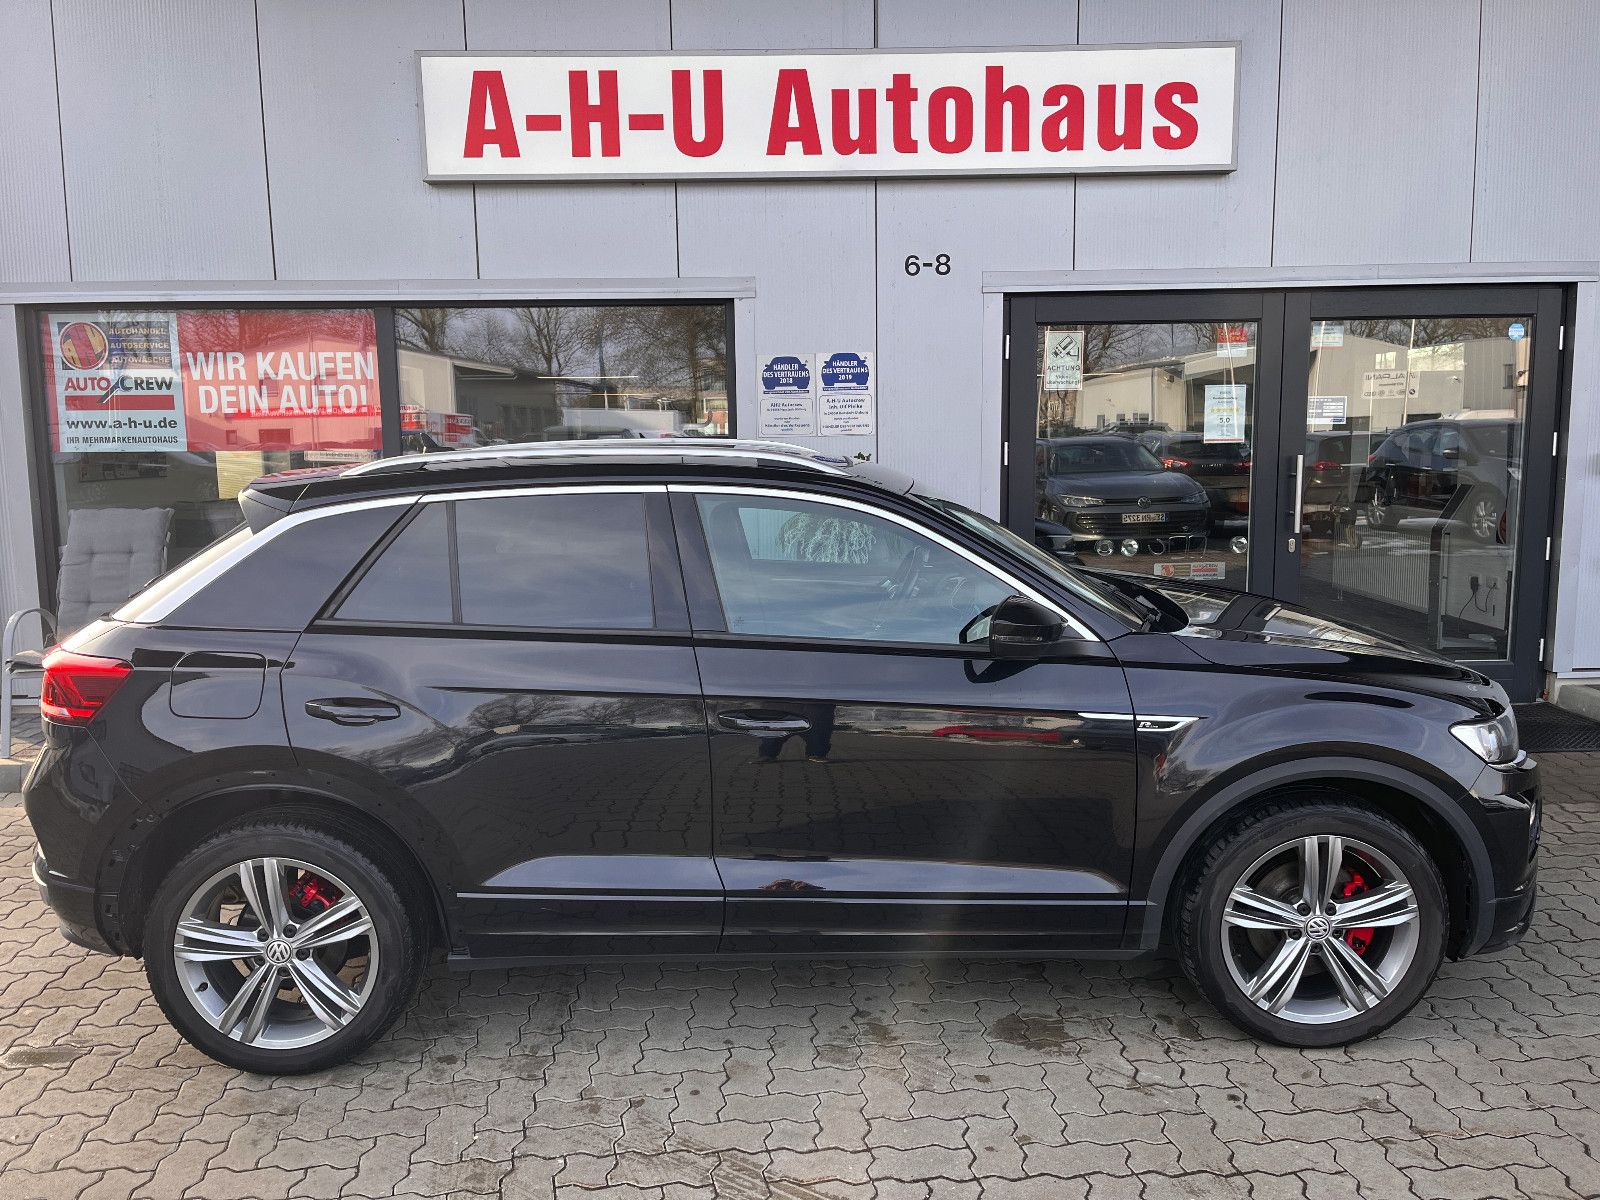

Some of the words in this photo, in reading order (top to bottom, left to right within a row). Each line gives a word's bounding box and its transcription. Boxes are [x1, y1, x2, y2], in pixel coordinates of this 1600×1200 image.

[463, 69, 724, 158] A-H-U
[766, 65, 1199, 156] Autohaus
[904, 253, 951, 276] 6-8
[108, 327, 166, 335] AUTOHANDEL
[186, 351, 247, 381] WIR
[256, 351, 374, 381] KAUFEN
[773, 363, 798, 371] HÄNDLER
[198, 385, 268, 414] DEIN
[279, 384, 368, 414] AUTO!
[66, 417, 178, 429] www.a-h-u.de
[82, 436, 178, 444] MEHRMARKENAUTOHAUS
